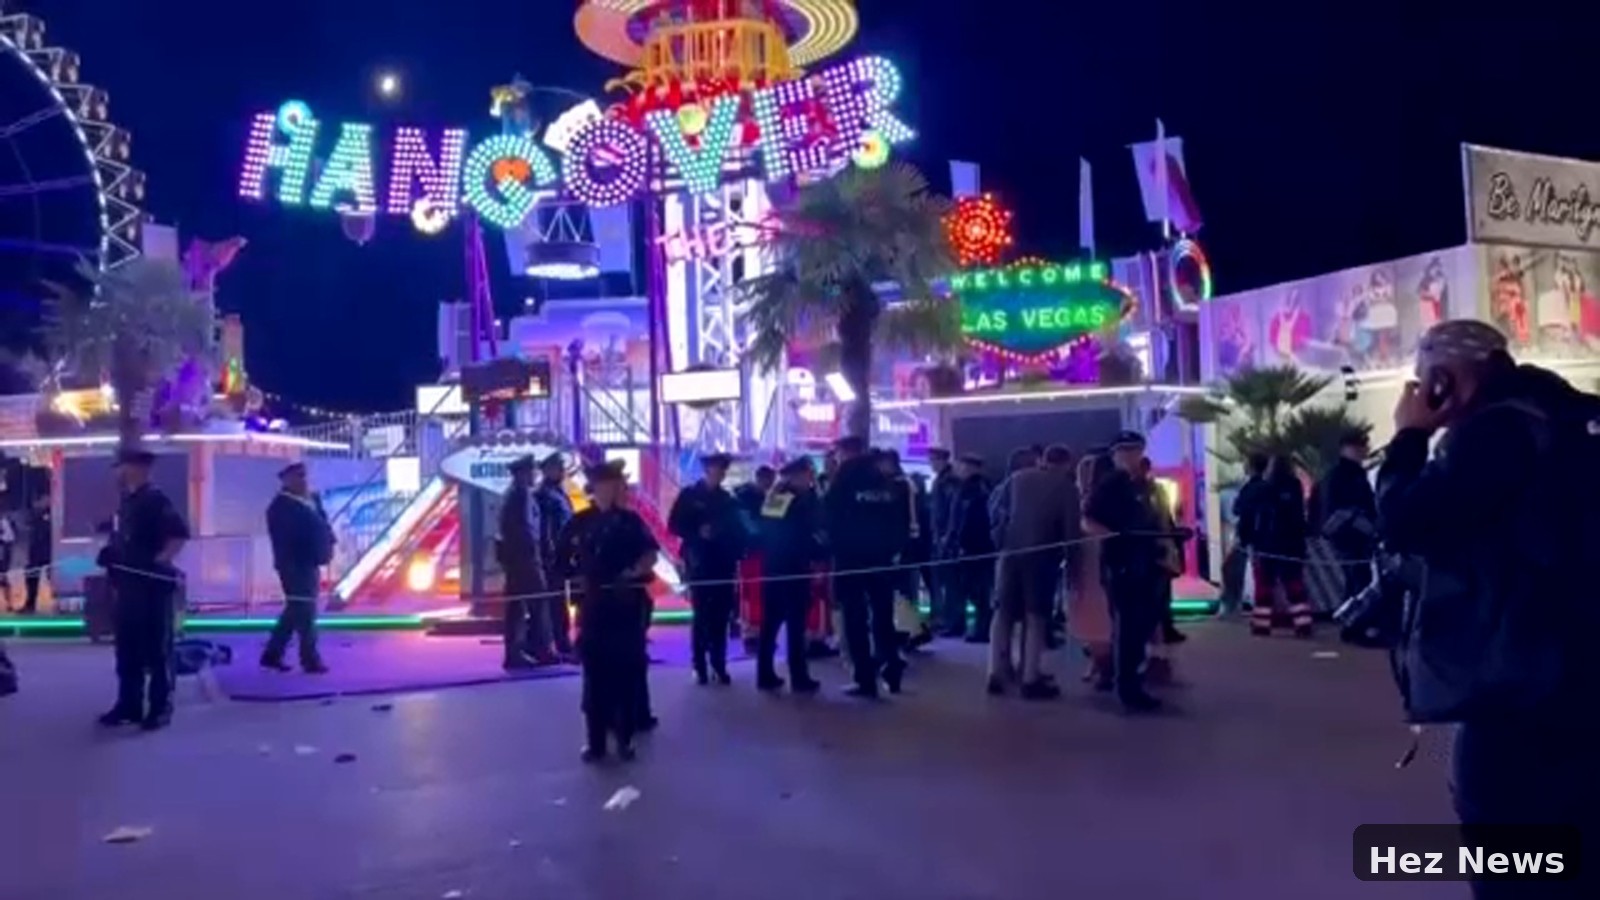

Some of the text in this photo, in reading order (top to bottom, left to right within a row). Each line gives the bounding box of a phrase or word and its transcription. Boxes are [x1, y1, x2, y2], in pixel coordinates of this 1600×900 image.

[239, 56, 916, 228] HANGOVER
[1487, 172, 1521, 221] Be
[951, 263, 1106, 289] WELCOME
[961, 304, 1106, 332] LAS VEGAS
